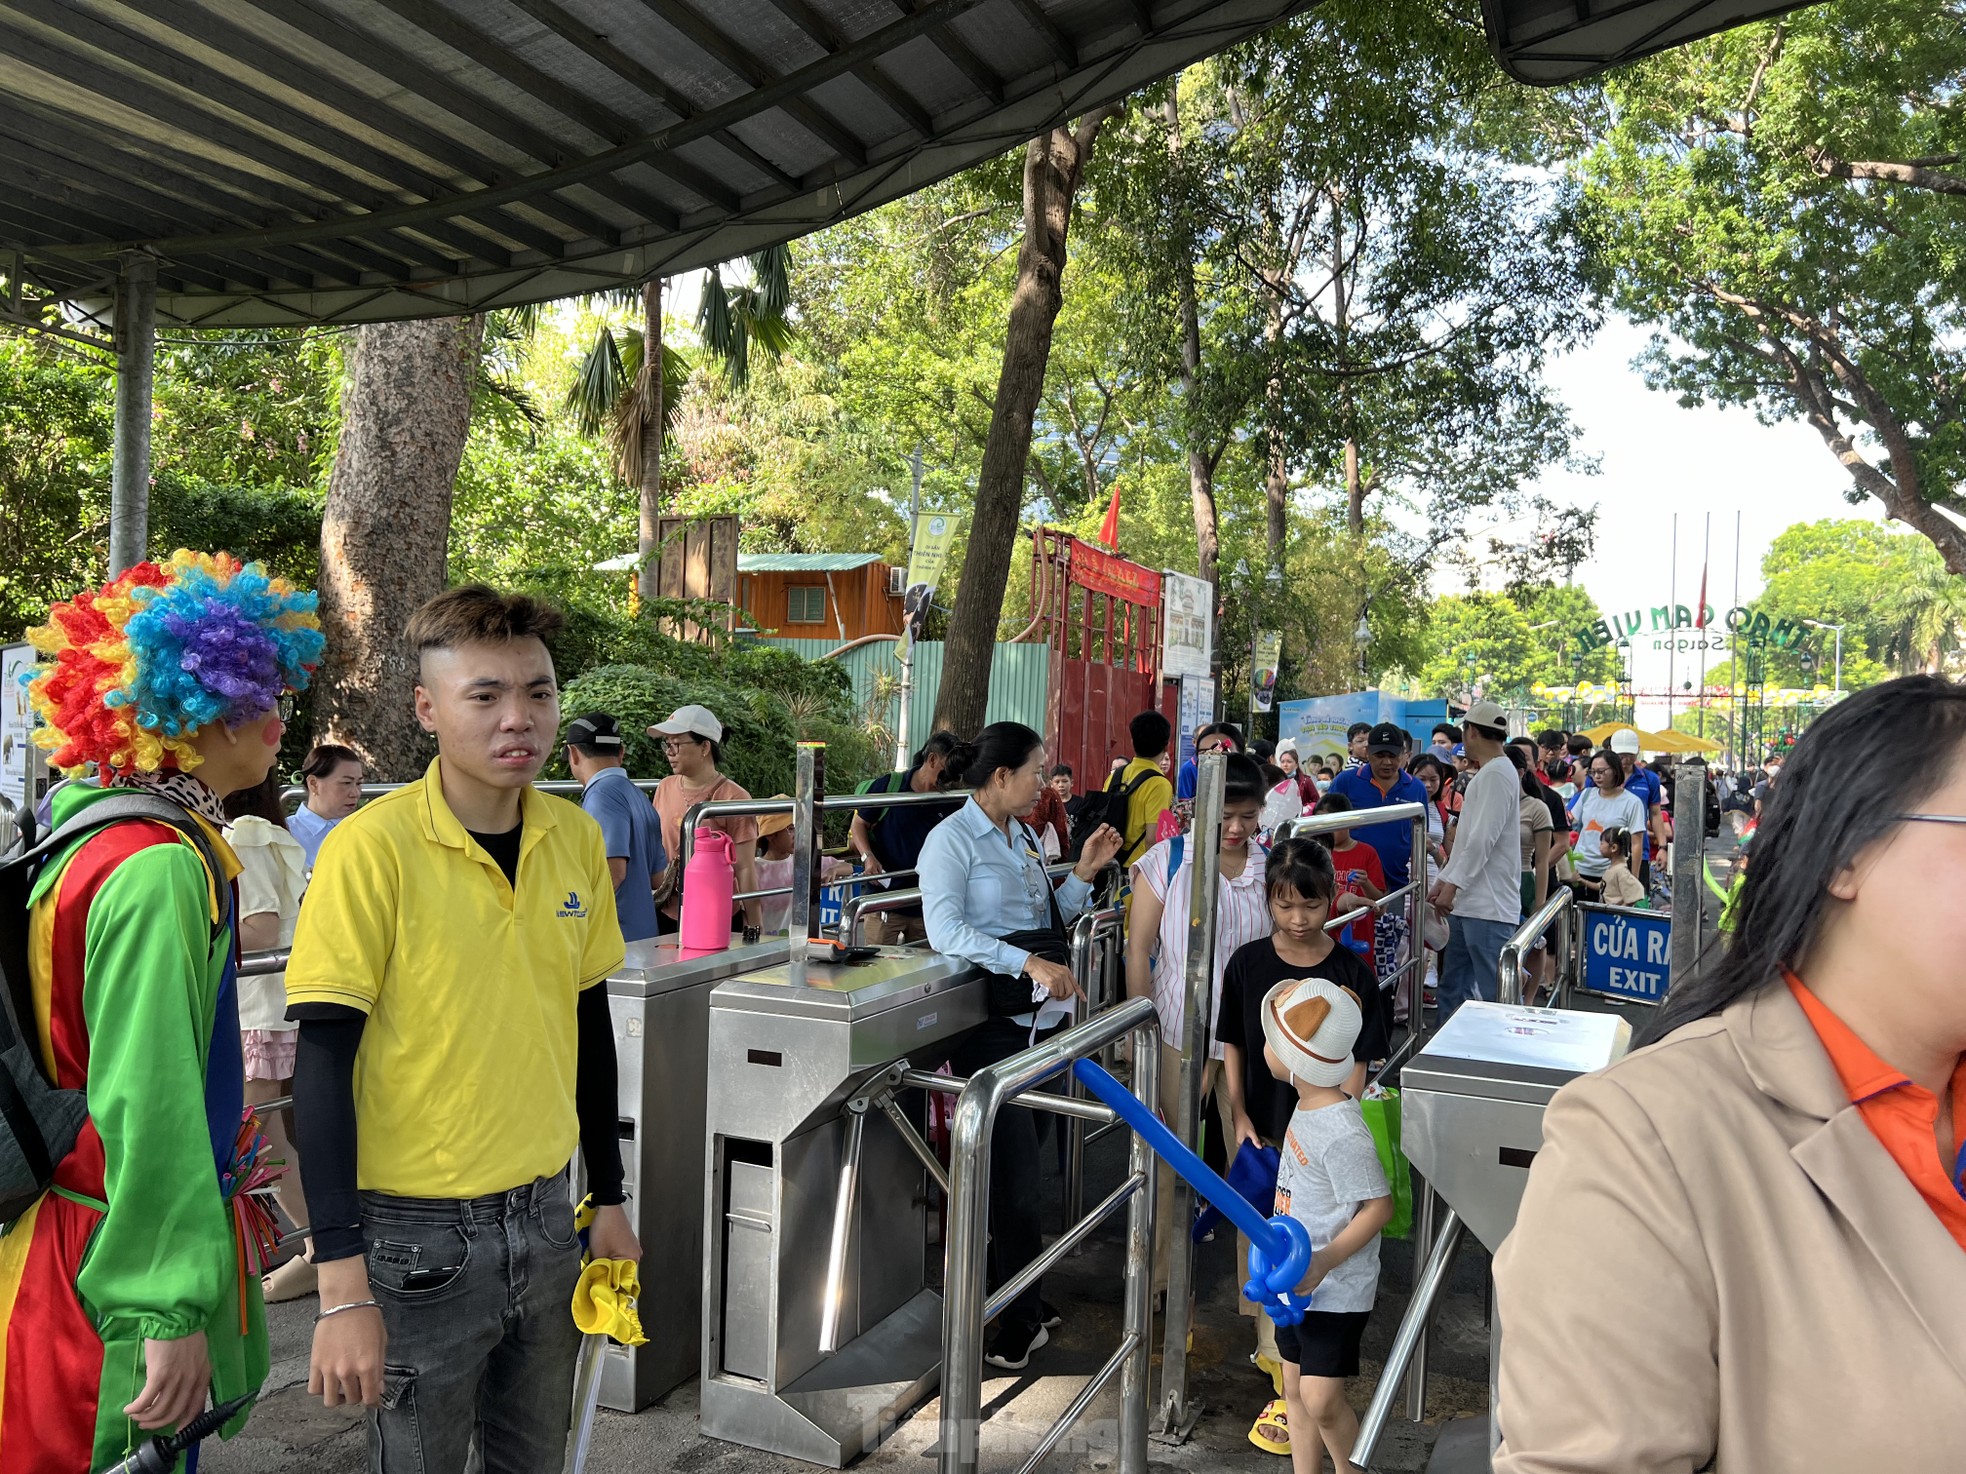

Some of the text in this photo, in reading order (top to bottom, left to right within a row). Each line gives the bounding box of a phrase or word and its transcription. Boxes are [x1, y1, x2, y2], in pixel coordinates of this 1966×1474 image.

[820, 907, 839, 924] IT
[1593, 914, 1639, 961] CỬA
[1609, 966, 1661, 995] EXIT
